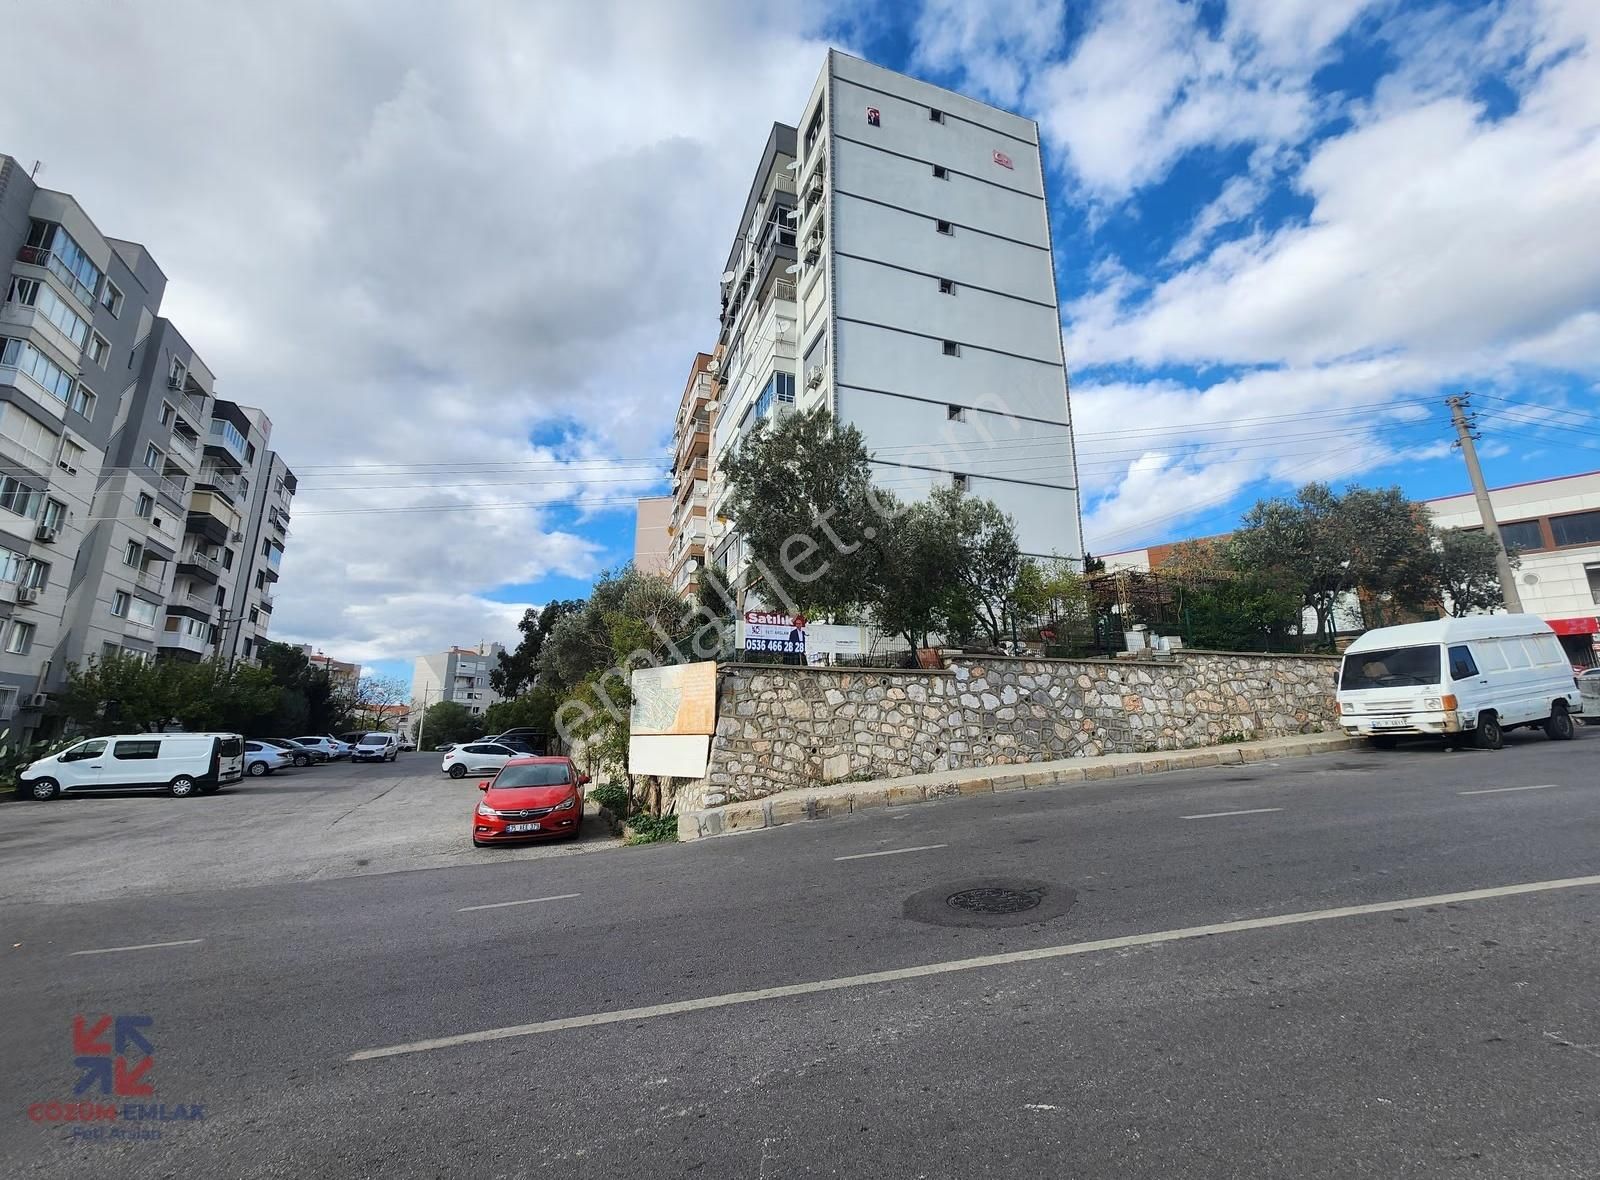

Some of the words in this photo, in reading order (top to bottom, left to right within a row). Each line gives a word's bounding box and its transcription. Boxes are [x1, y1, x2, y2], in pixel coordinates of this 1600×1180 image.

[748, 613, 794, 626] Satılık
[746, 639, 766, 651] 0536
[767, 640, 783, 652] 466
[784, 641, 794, 652] 28
[795, 642, 805, 653] 28
